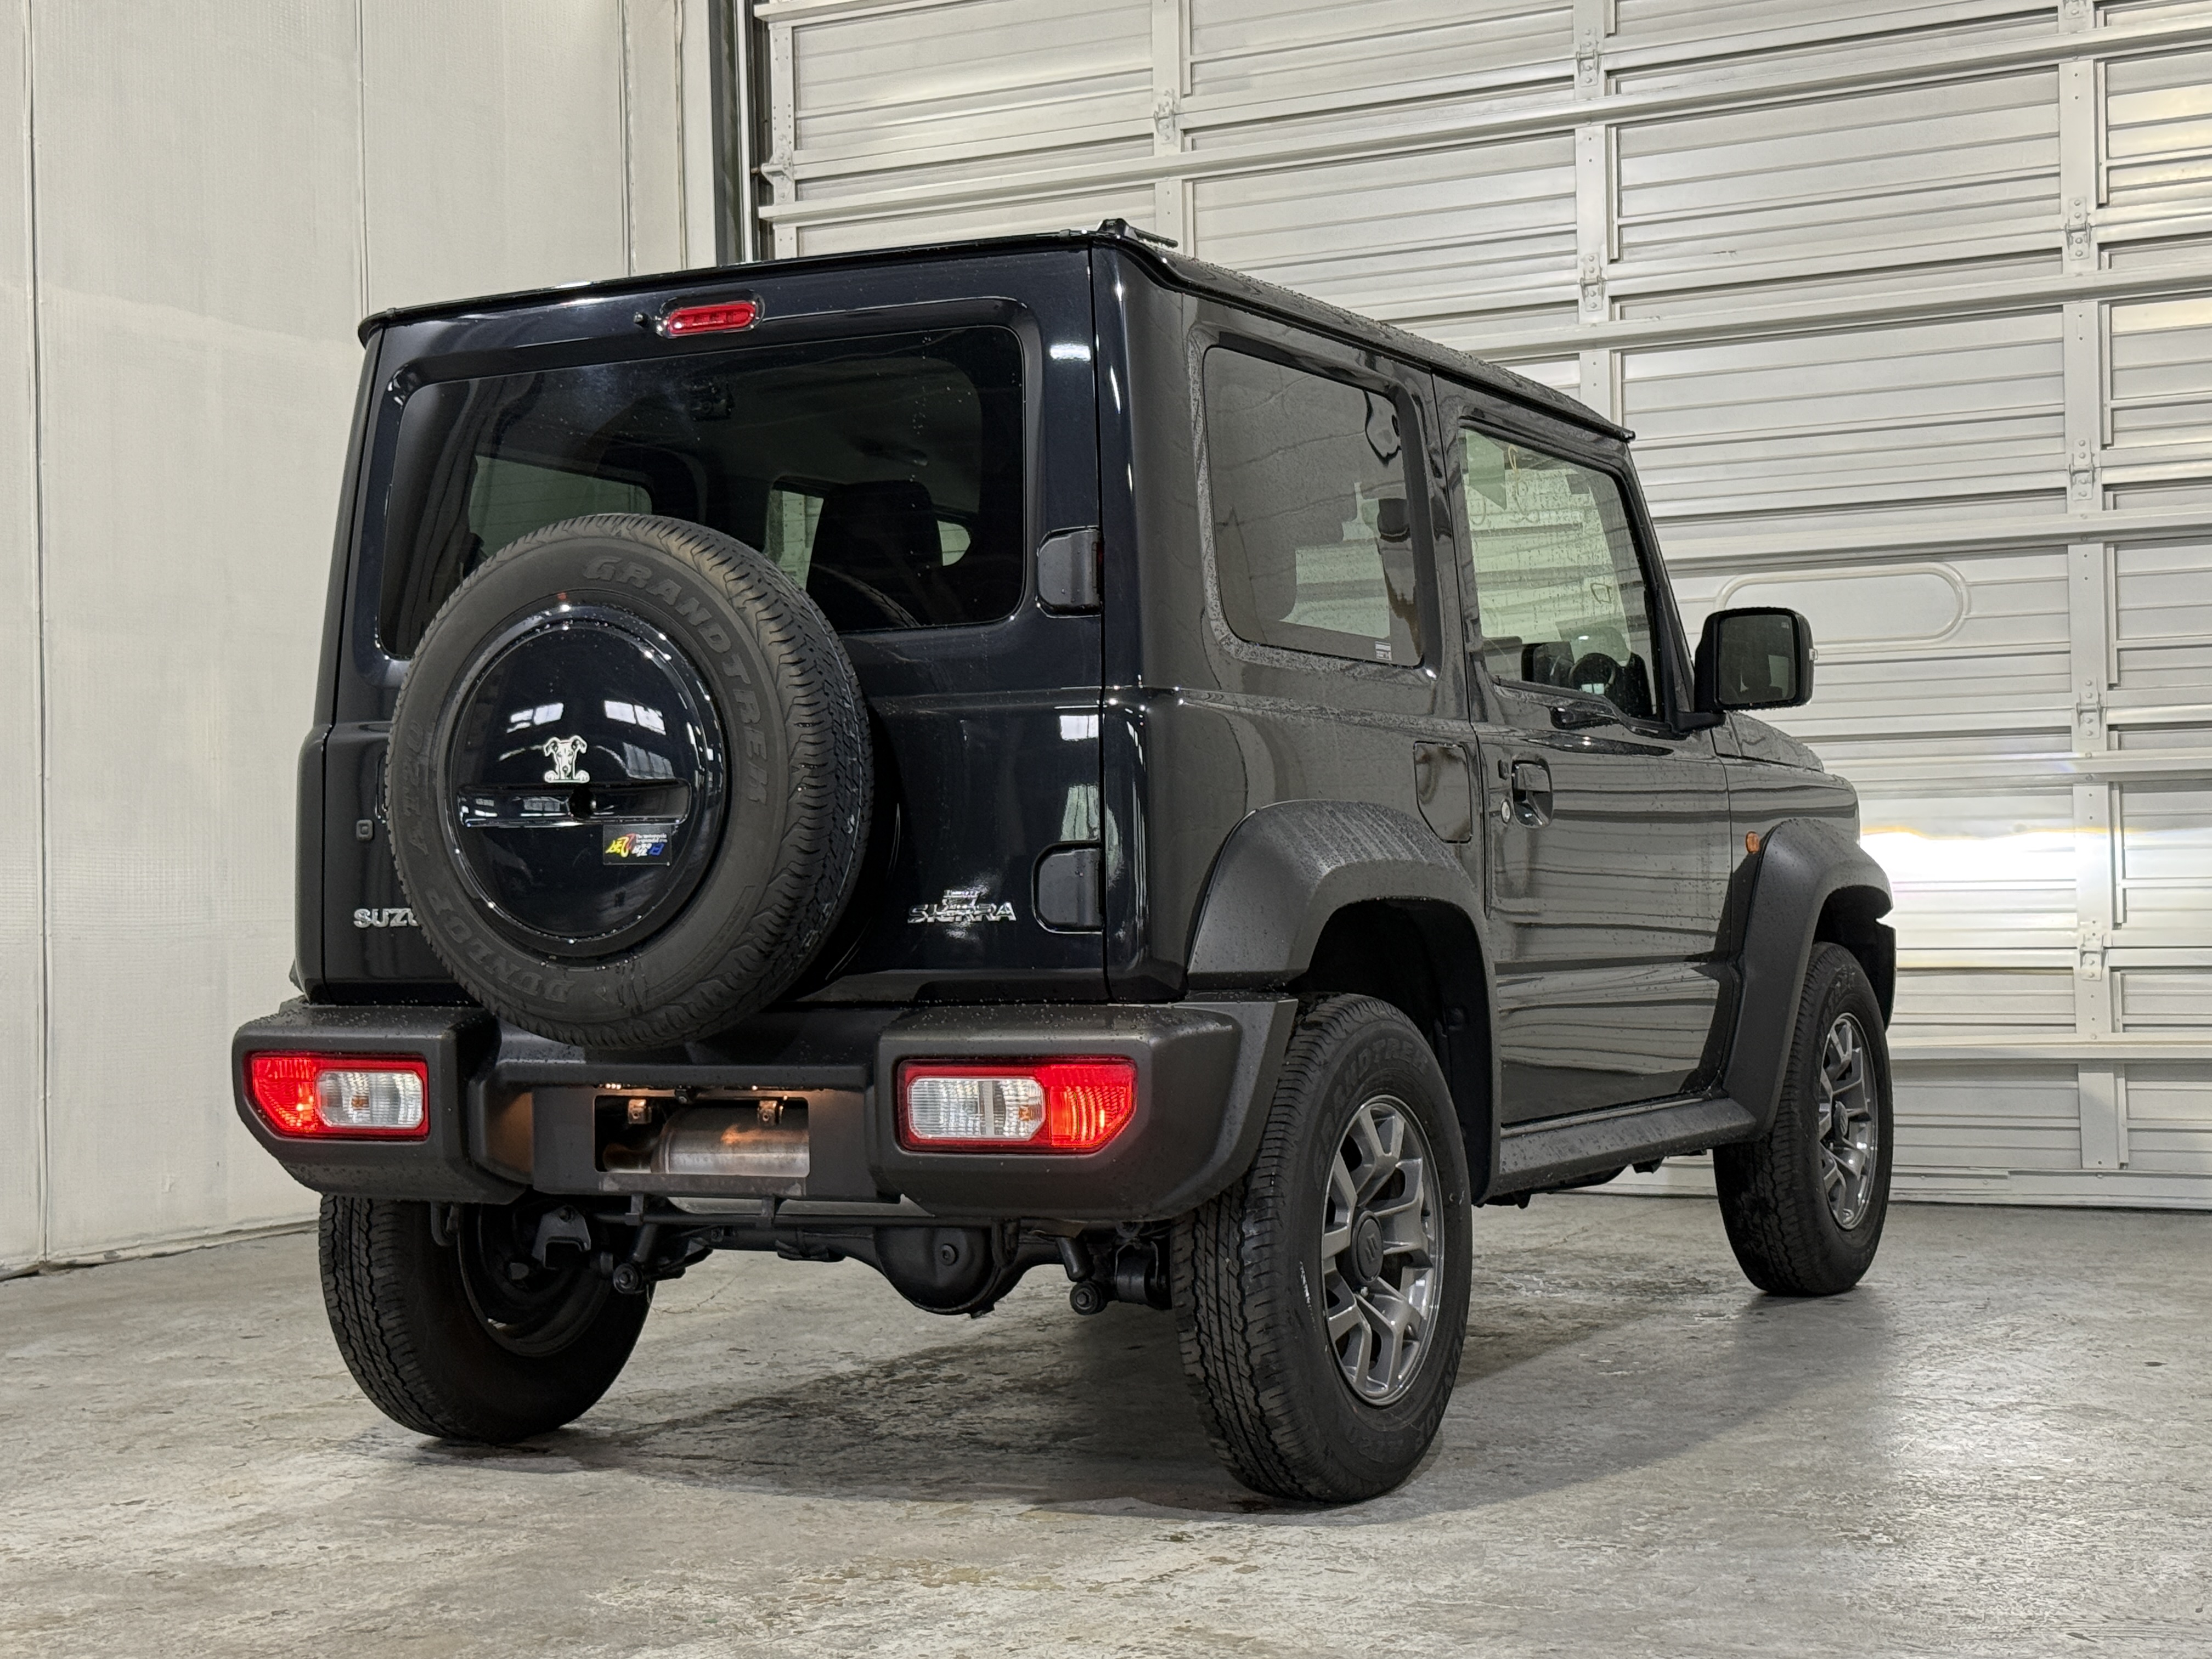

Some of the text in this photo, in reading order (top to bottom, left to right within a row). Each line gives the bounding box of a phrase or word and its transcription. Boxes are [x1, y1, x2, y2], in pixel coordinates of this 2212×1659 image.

[583, 557, 767, 805] GRANDTREK
[425, 889, 575, 1003] DUNLOP
[907, 901, 1017, 924] SIERRA
